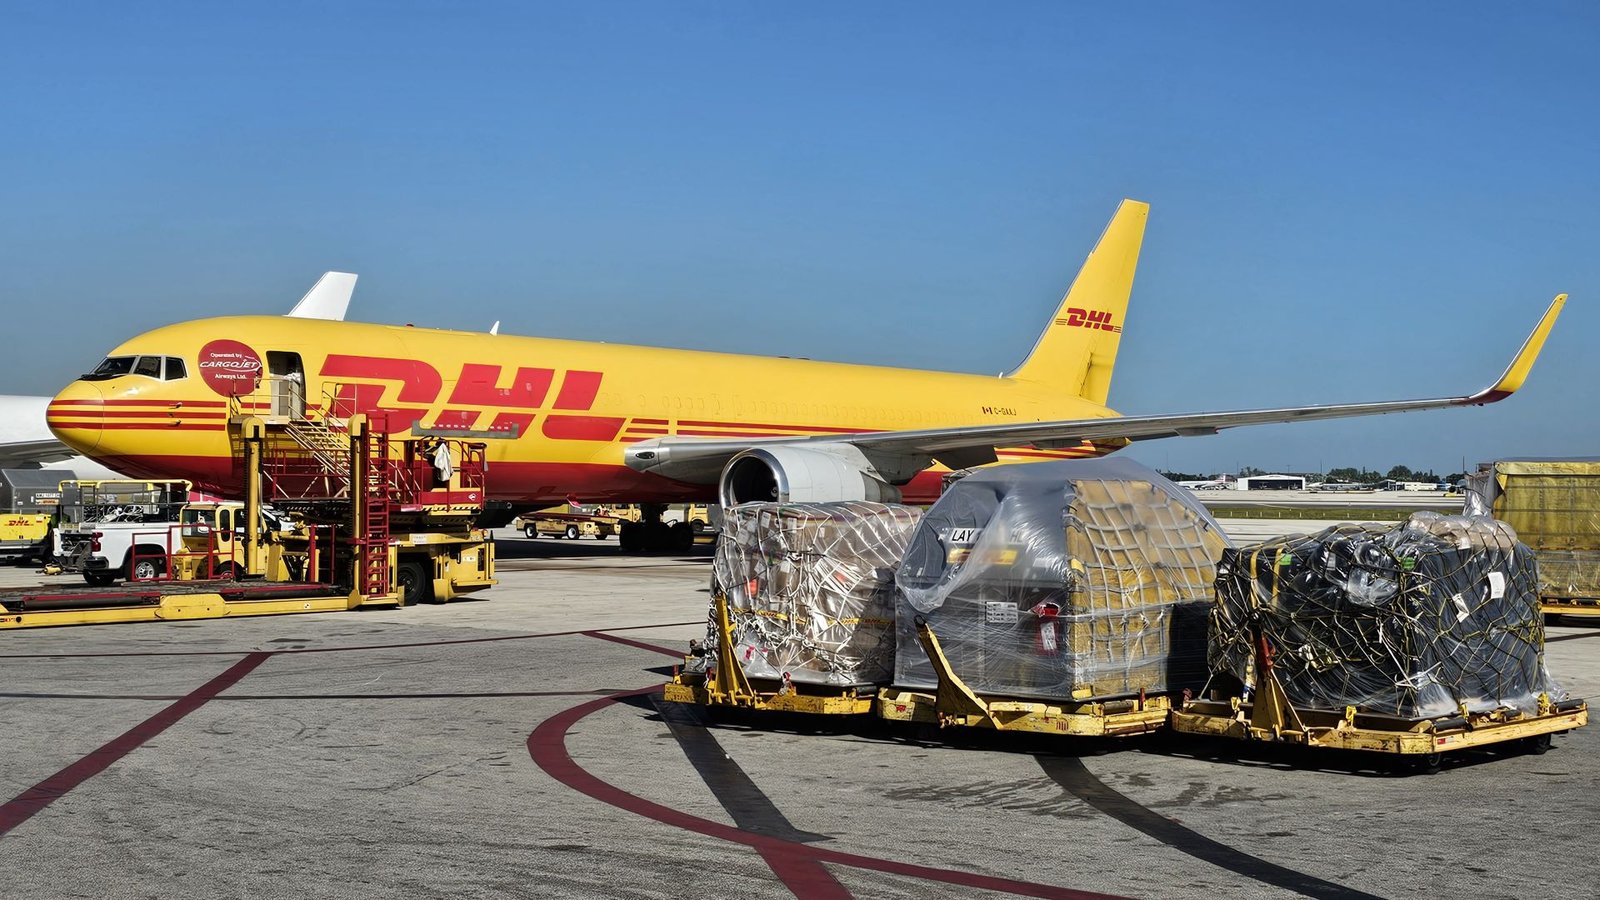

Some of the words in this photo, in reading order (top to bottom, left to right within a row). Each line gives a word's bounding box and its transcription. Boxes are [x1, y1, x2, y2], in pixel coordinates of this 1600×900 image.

[1067, 307, 1114, 332] DHL
[200, 359, 257, 368] CARGOJET
[319, 354, 626, 441] DHL
[952, 529, 974, 542] LAY
